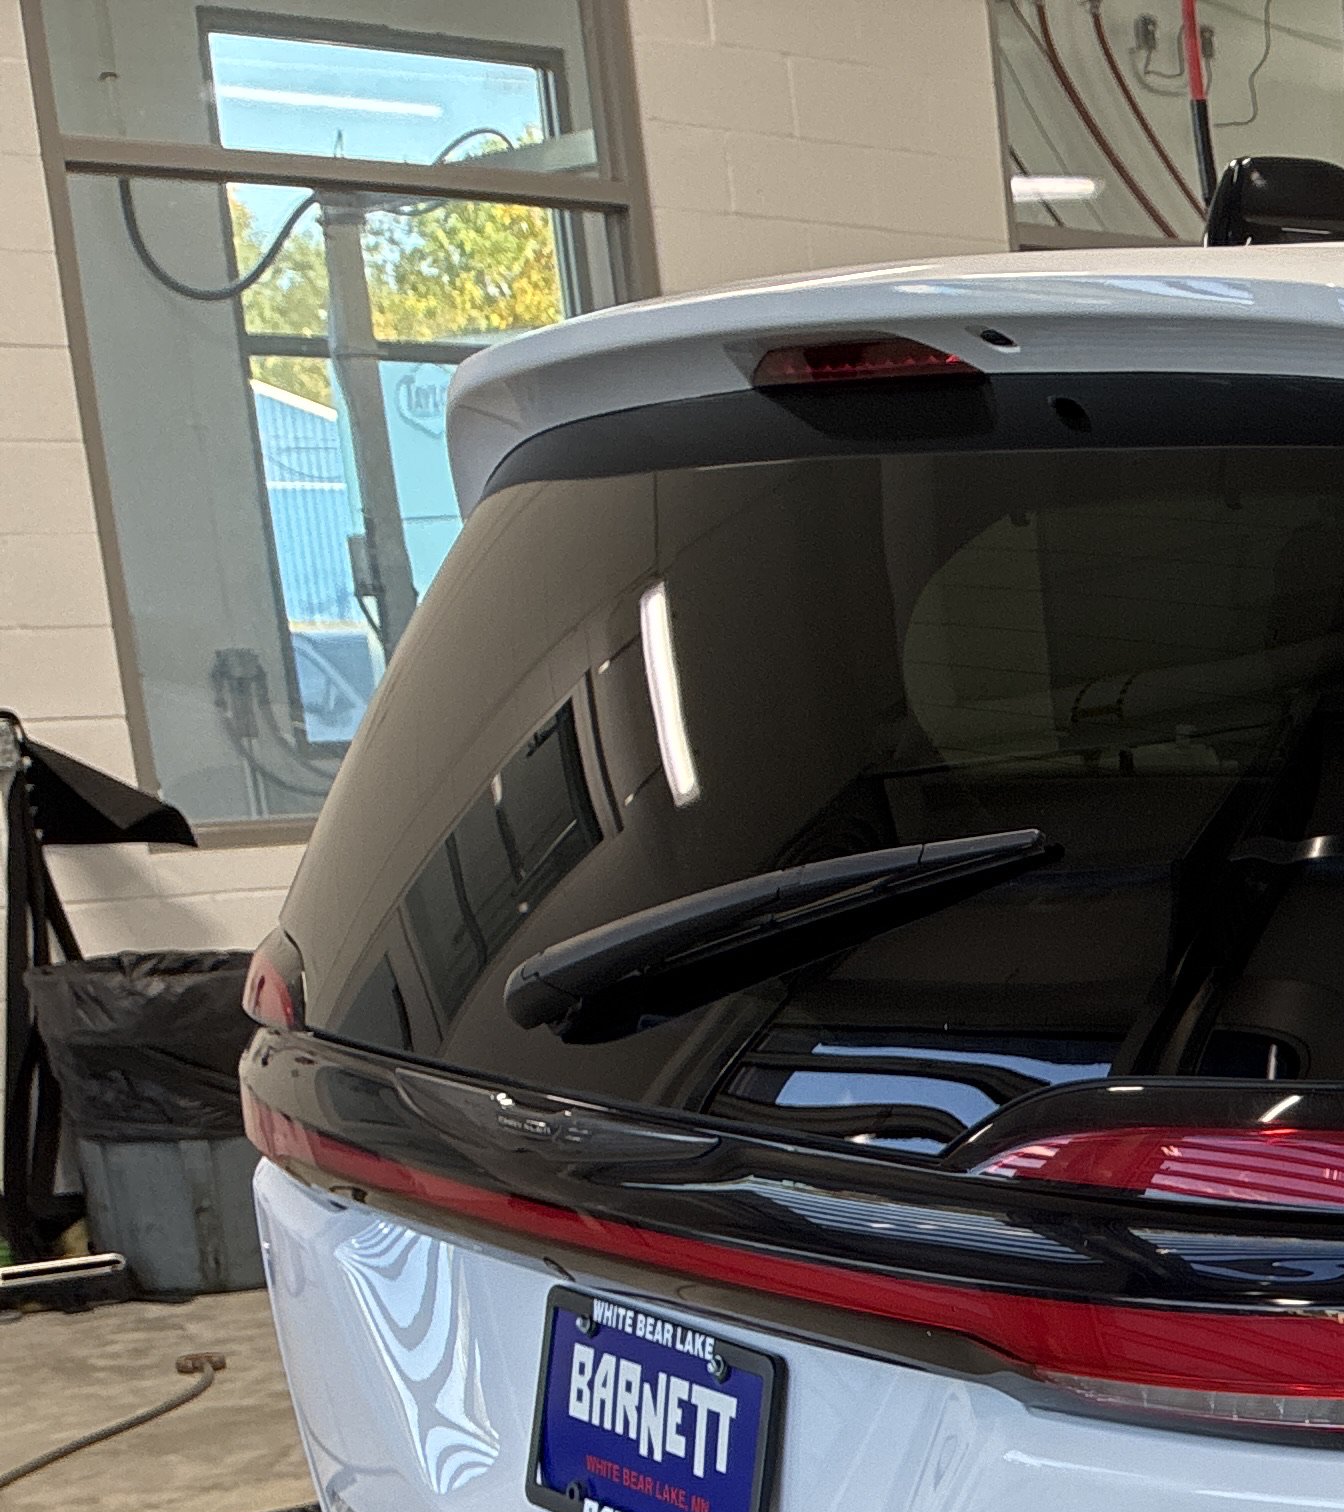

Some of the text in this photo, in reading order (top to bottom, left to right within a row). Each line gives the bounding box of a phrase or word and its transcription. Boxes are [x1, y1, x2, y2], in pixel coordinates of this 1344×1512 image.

[592, 1299, 715, 1360] WHITE BEAR LAKE
[569, 1342, 737, 1479] BARNETT
[585, 1455, 620, 1482] WHITE
[622, 1471, 653, 1493] BEAR
[654, 1479, 689, 1512] LAKE,
